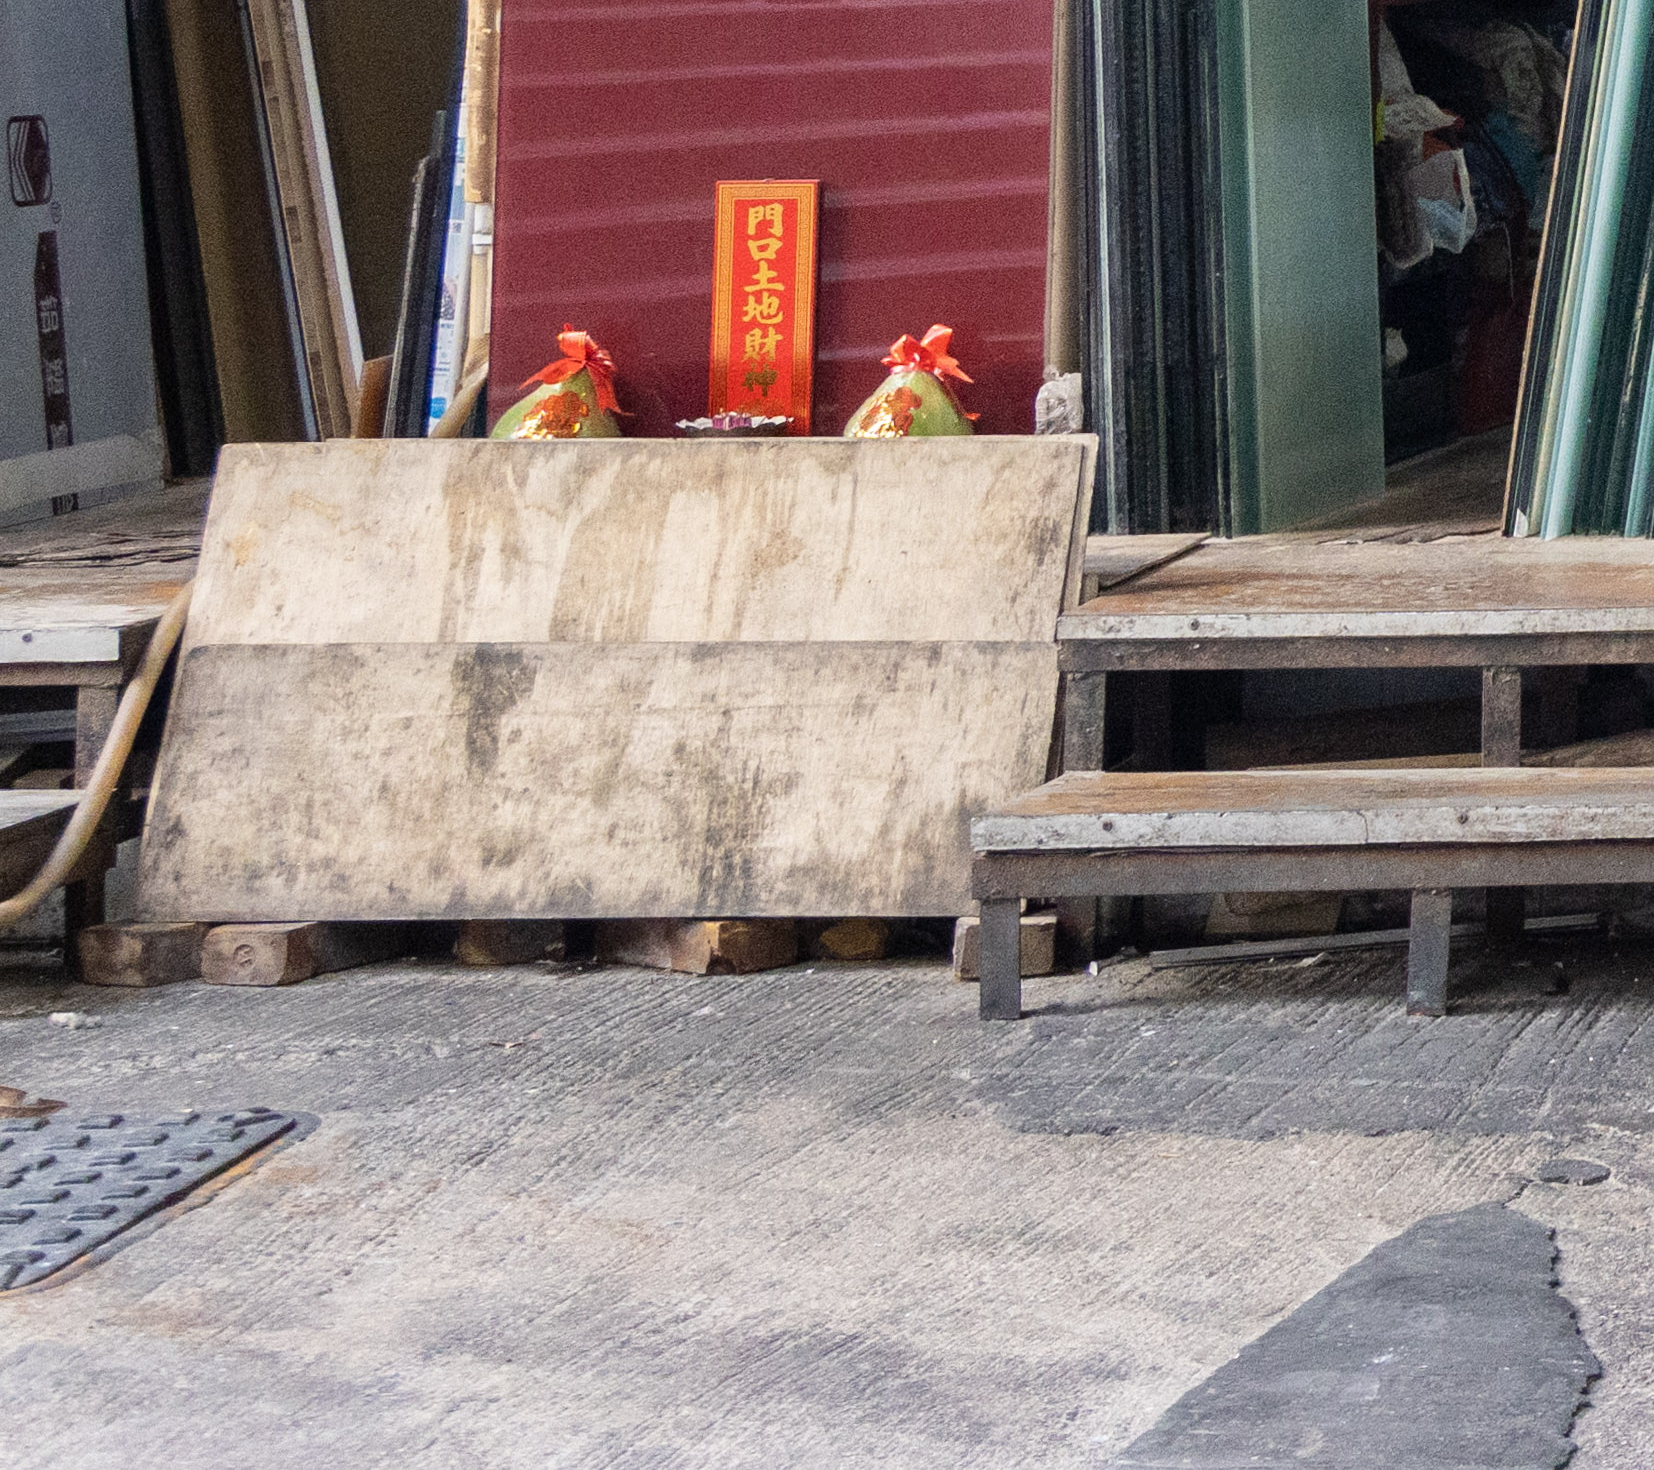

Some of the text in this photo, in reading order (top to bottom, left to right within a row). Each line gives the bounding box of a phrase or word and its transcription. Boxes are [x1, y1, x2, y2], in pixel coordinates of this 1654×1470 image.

[742, 201, 786, 399] 門口土地財神
